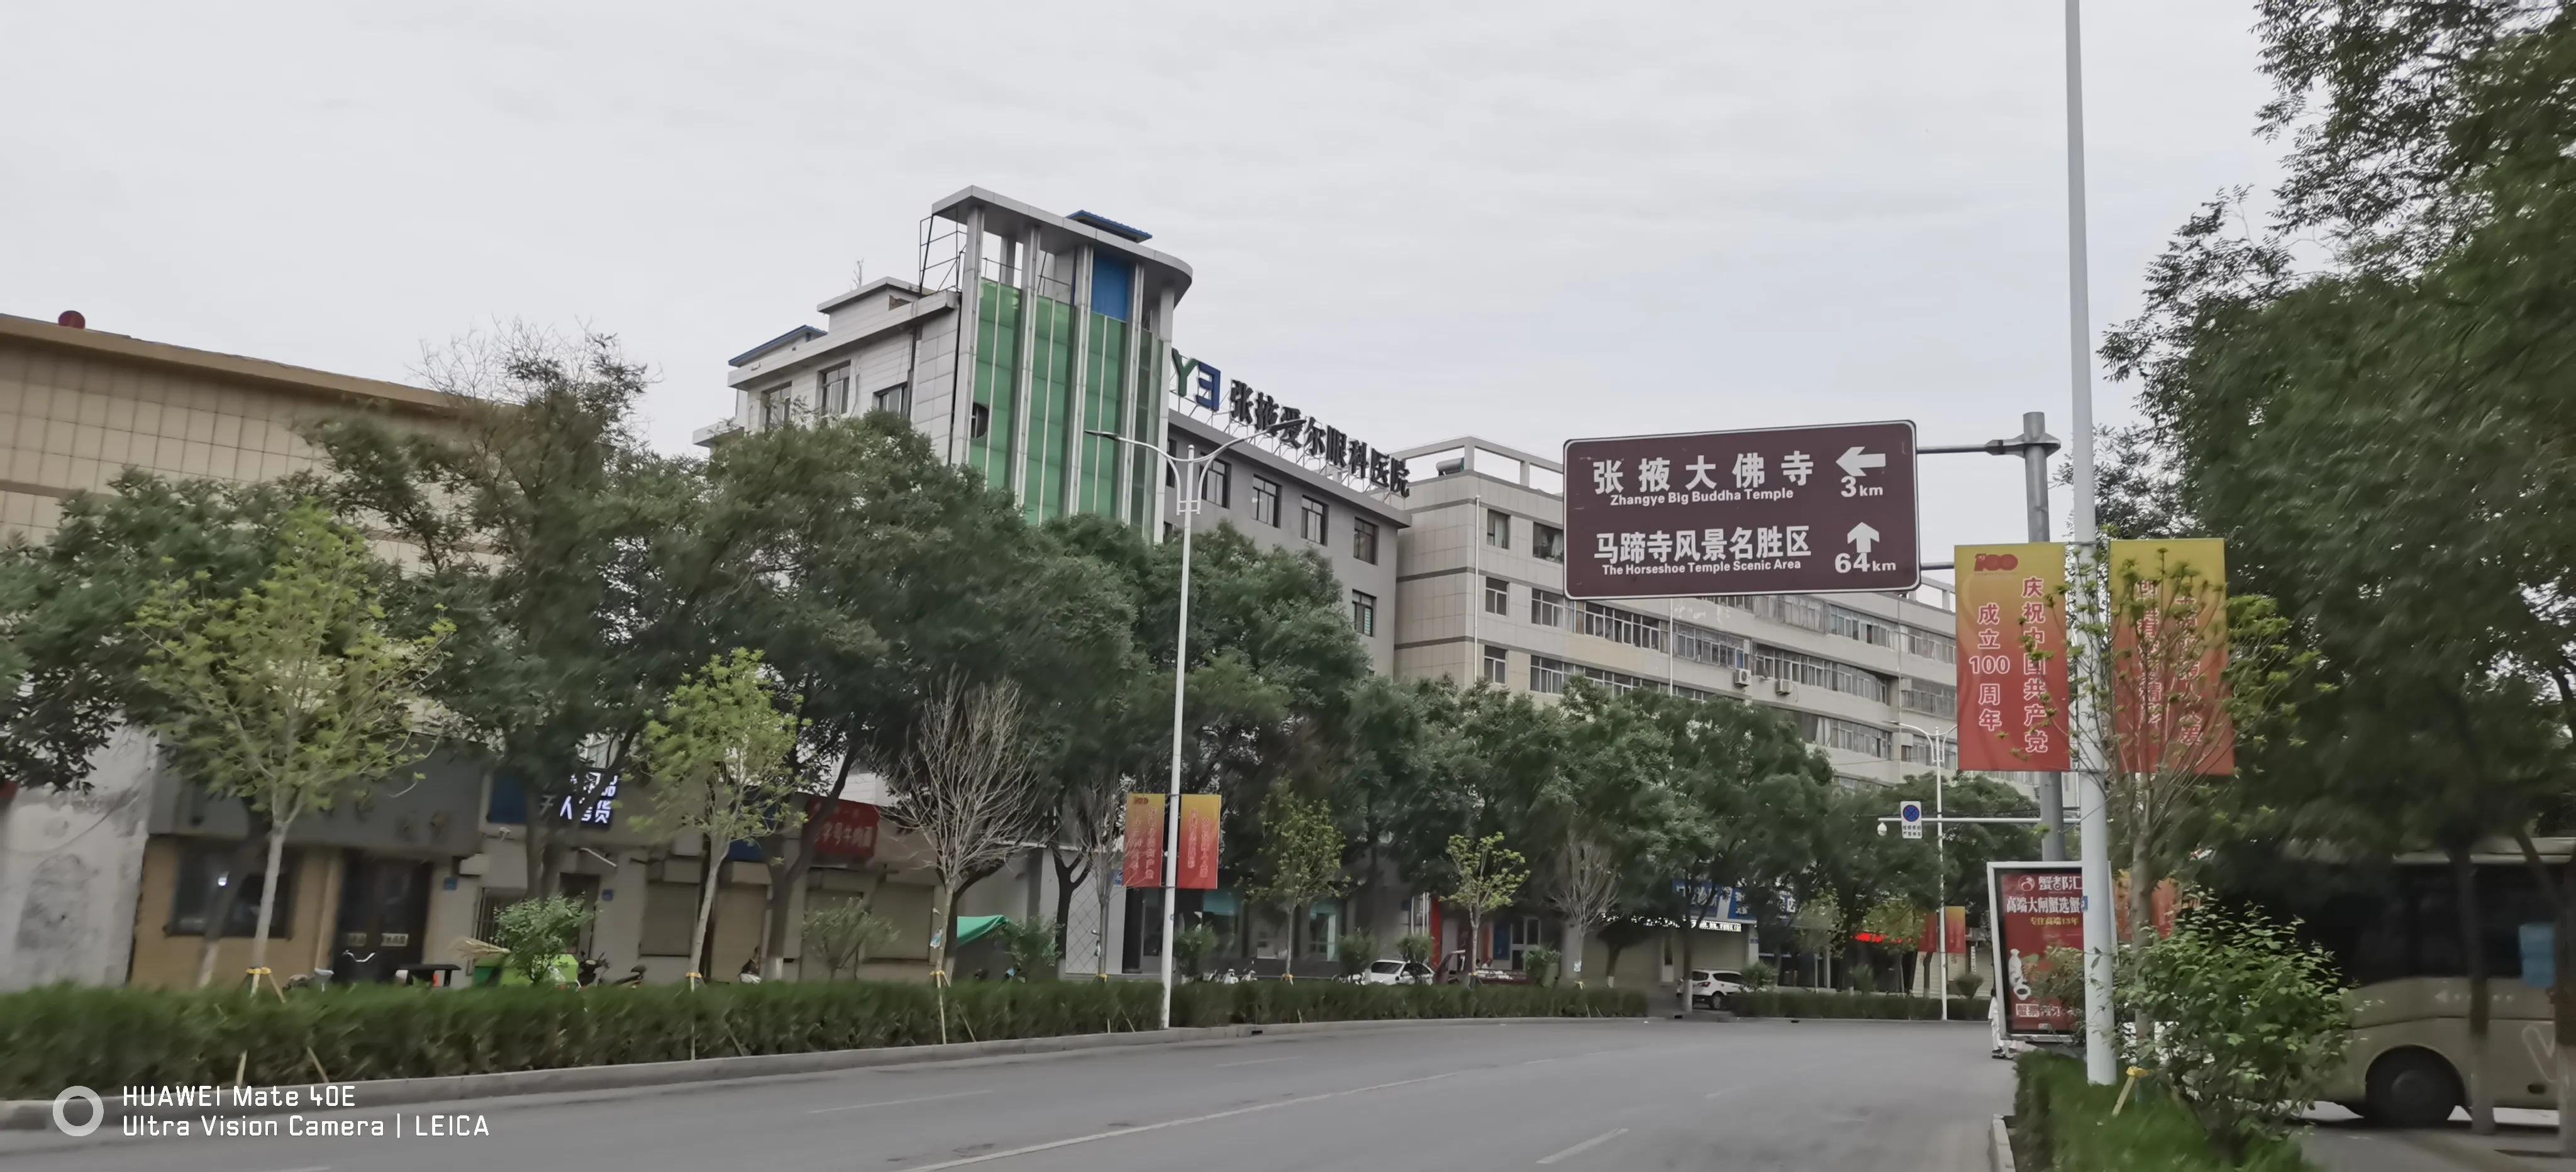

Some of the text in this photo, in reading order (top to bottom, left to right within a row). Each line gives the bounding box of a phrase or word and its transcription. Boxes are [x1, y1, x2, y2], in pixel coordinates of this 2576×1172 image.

[1230, 378, 1410, 498] 张掖爱尔眼科医院
[1592, 450, 1814, 495] 张掖大佛寺
[1610, 487, 1794, 506] Zhangye Big Buddha Temple
[1594, 526, 1811, 565] 马蹄寺风景名胜区
[1602, 558, 1801, 575] The Horseshoe Temple Scenic Area
[2021, 576, 2048, 753] 庆祝中国共产党
[2038, 875, 2083, 891] 蟹都汇
[2006, 895, 2084, 914] 高端大闸蟹选蟹
